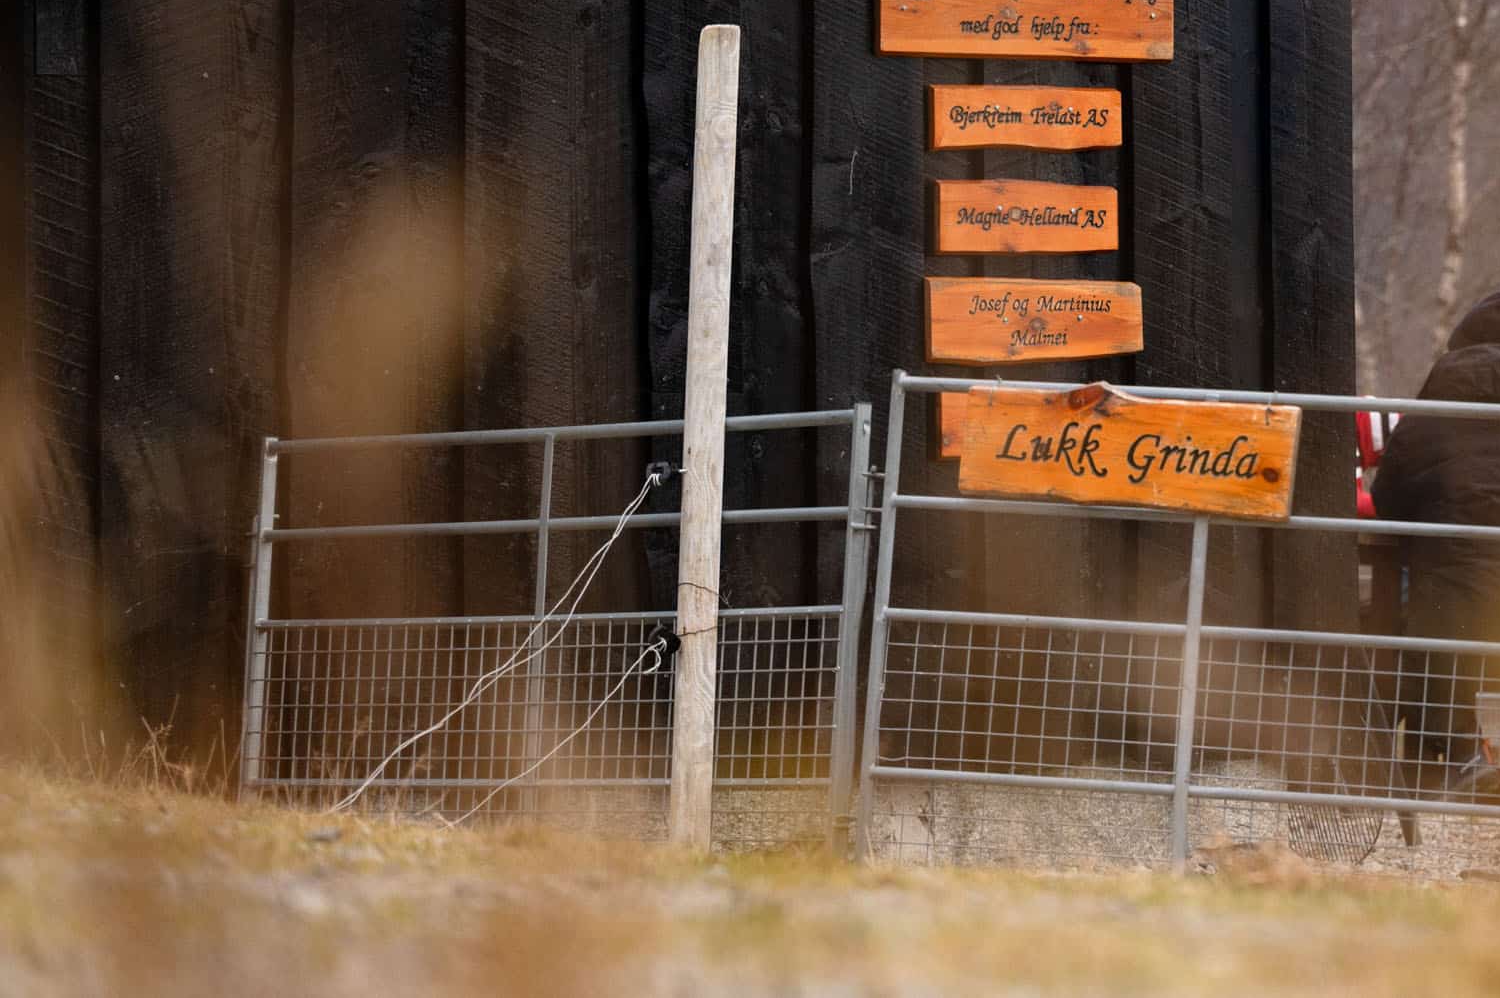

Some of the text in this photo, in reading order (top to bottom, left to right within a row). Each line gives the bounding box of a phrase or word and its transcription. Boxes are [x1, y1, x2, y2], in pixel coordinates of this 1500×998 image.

[960, 14, 993, 33] med
[992, 15, 1023, 40] god
[1031, 16, 1065, 41] hjelp
[1031, 106, 1081, 126] Trelast
[1082, 108, 1109, 128] AS
[957, 207, 1107, 231] Magne Helland AS
[969, 292, 1112, 318] Josef og Martinius
[1010, 328, 1069, 347] Malmei
[995, 421, 1260, 484] Lukk Grinda
